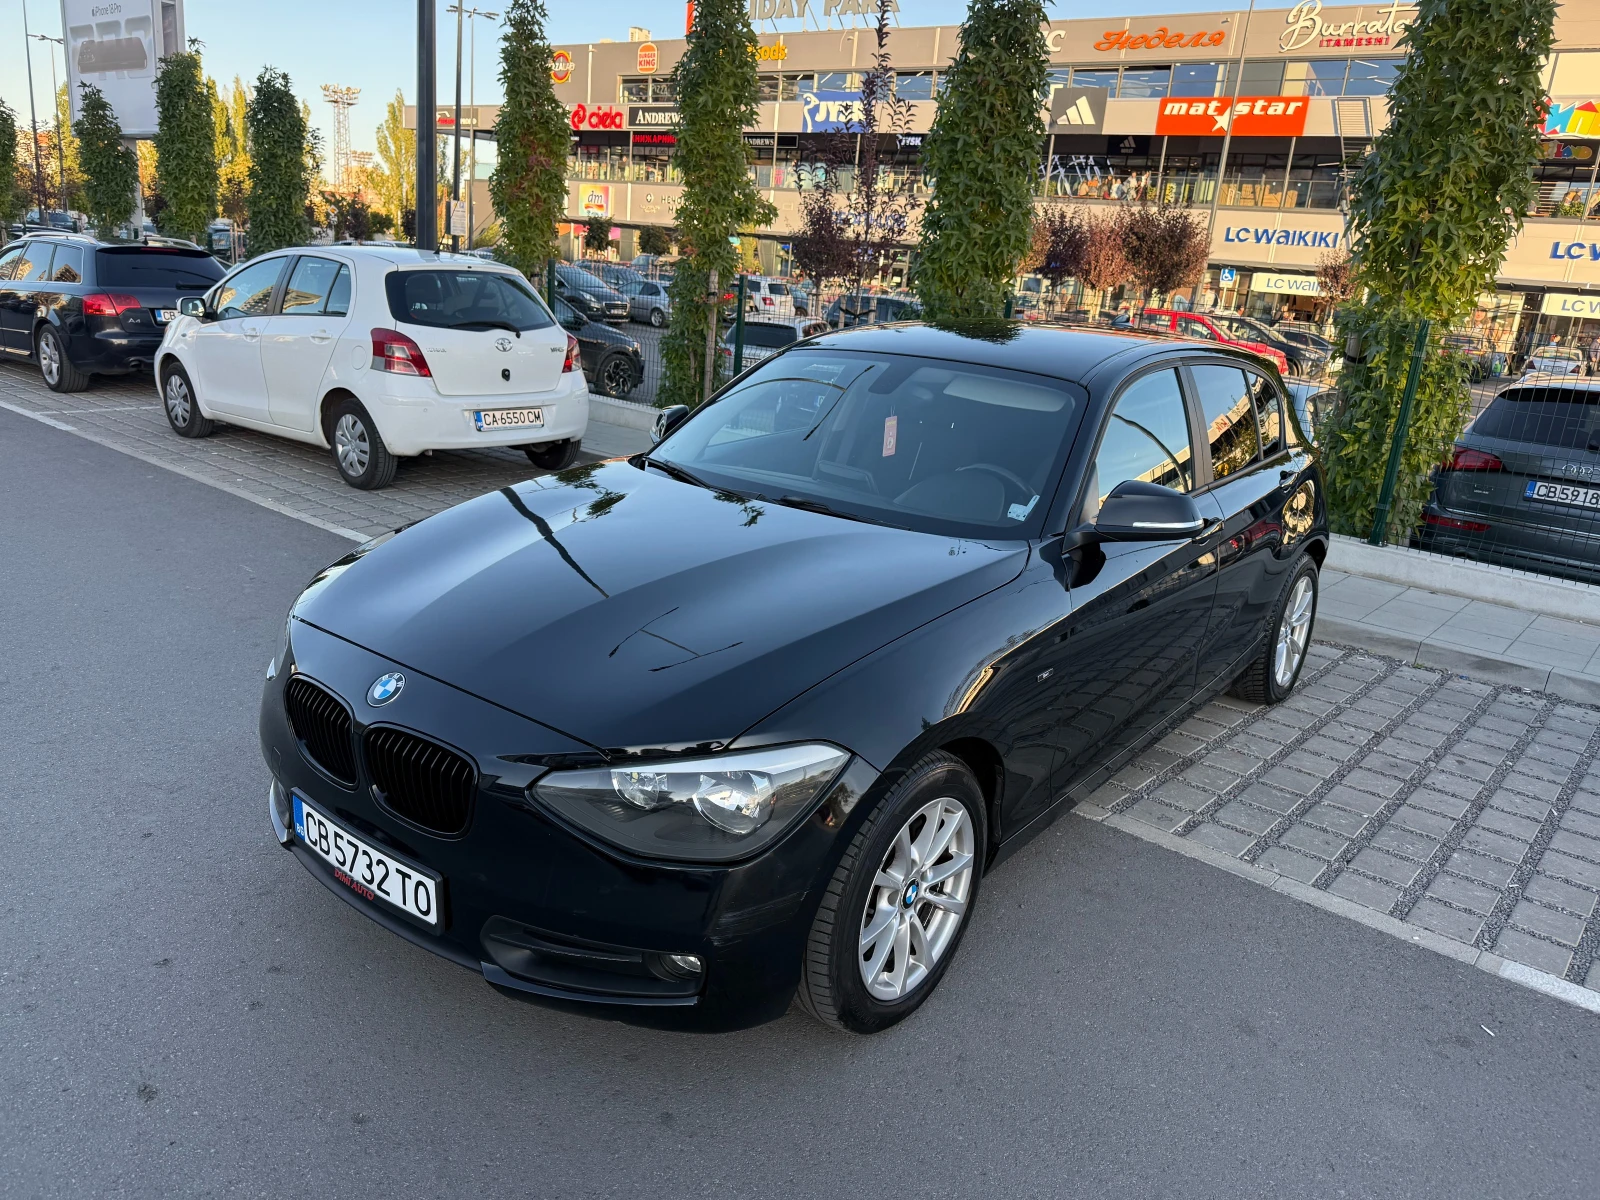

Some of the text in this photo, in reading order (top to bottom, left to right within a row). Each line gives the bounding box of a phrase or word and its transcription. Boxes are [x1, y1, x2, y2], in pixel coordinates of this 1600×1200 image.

[748, 0, 806, 20] IDAY
[1093, 26, 1226, 51] Неделя
[1319, 36, 1391, 47] ITAMESHI
[638, 59, 656, 67] KING
[636, 108, 683, 124] ANDREW
[1163, 100, 1303, 116] mat star
[587, 104, 624, 130] ciela
[900, 136, 922, 146] JYSK
[588, 190, 603, 203] dm
[1225, 226, 1251, 243] LC
[1549, 241, 1587, 260] LC
[1266, 277, 1286, 289] LC
[1561, 299, 1586, 312] LC
[163, 311, 176, 321] CB
[483, 412, 499, 426] CA
[500, 411, 526, 425] 6550
[527, 410, 542, 423] CM
[1537, 485, 1558, 498] CB
[296, 822, 304, 836] BG
[305, 811, 431, 917] CB 5732 TO
[334, 868, 375, 901] DIMI AUTO
